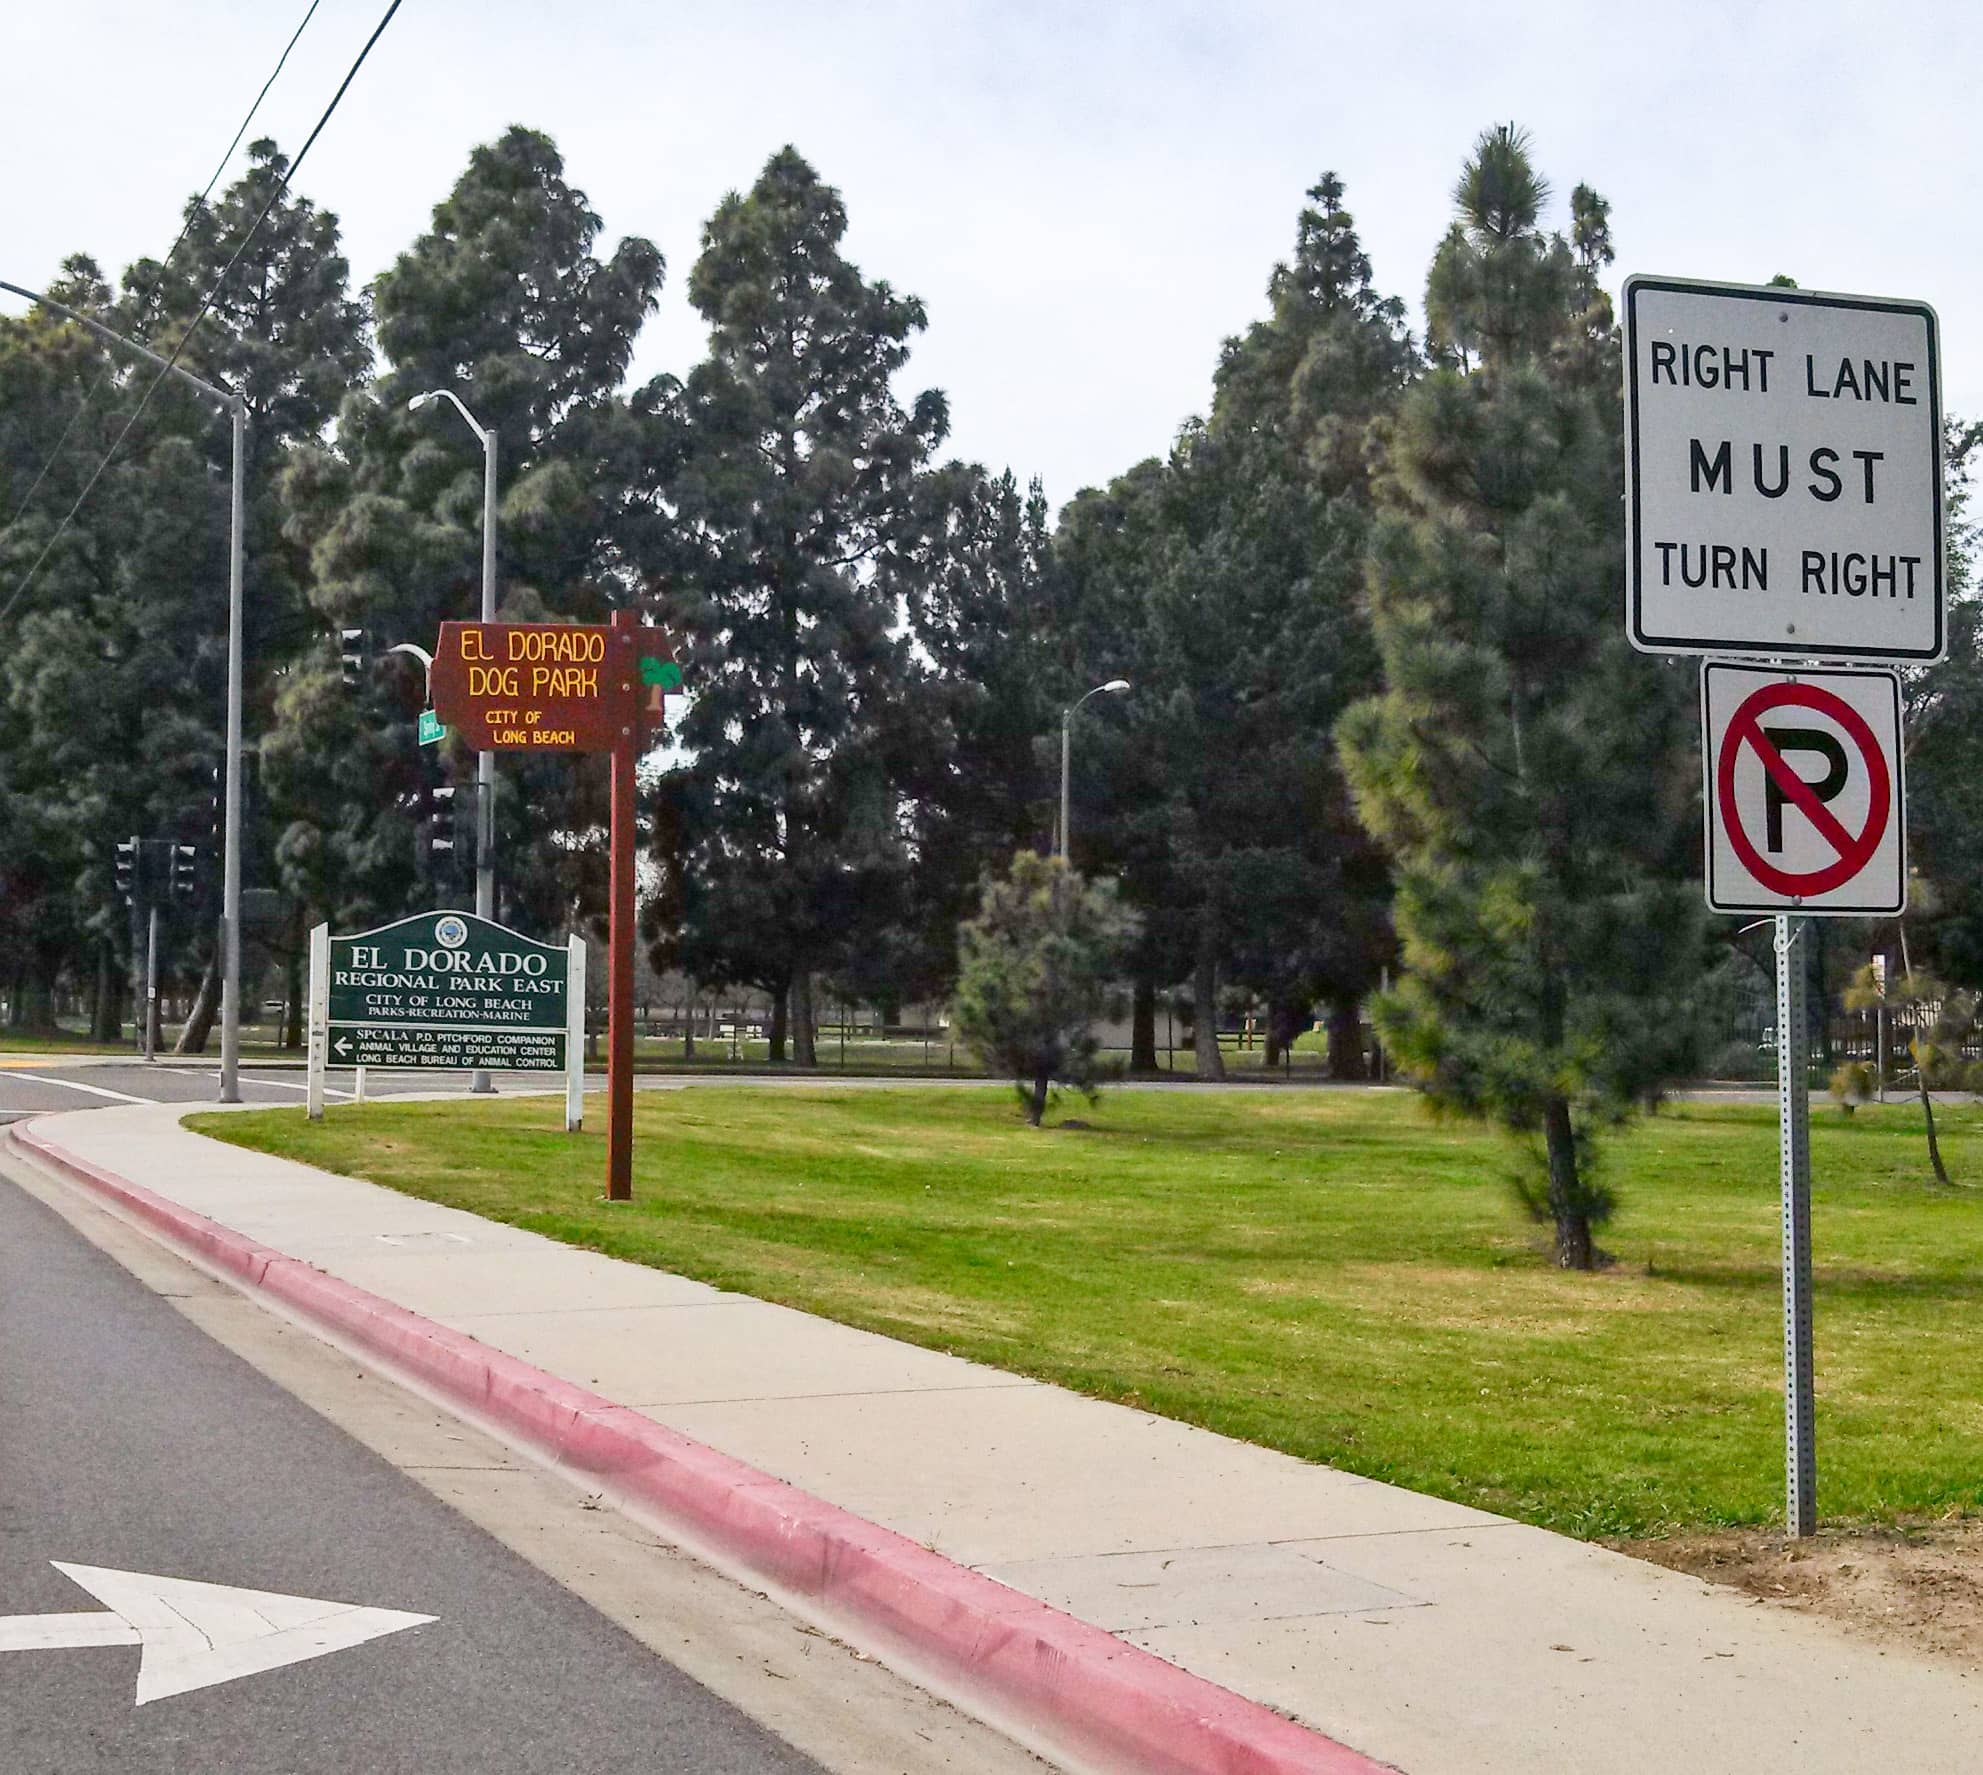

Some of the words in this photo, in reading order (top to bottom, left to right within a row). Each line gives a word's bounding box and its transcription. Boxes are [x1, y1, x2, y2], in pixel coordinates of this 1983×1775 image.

[1651, 341, 1774, 392] RIGHT
[1806, 354, 1917, 405] LANE
[1689, 439, 1884, 504] MUST
[1654, 542, 1767, 591] TURN
[1801, 551, 1921, 599] RIGHT
[460, 630, 494, 661] EL
[508, 631, 605, 663] DORADO
[469, 667, 519, 697] DOG
[532, 667, 598, 698] PARK
[485, 711, 518, 724] CITY
[525, 711, 542, 724] OF
[493, 730, 527, 744] LONG
[533, 731, 575, 745] BEACH
[1763, 727, 1849, 853] P
[351, 946, 388, 969] EL
[404, 948, 548, 976] DORADO
[335, 971, 440, 989] REGIONAL
[449, 976, 503, 992] PARK
[513, 978, 564, 994] EAST
[365, 993, 402, 1005] CITY
[409, 995, 429, 1007] OF
[436, 996, 477, 1009] LONG
[484, 998, 532, 1010] BEACH
[359, 1042, 394, 1052] ANIMAL
[398, 1043, 438, 1053] VILLAGE
[441, 1044, 461, 1054] AND
[465, 1045, 517, 1055] EDUCATION
[520, 1046, 557, 1057] CENTER
[437, 1033, 493, 1044] PITCHFORD
[497, 1035, 556, 1046] COMPANION
[356, 1053, 382, 1063] LONG
[386, 1054, 418, 1064] BEACH
[420, 1055, 458, 1065] BUREAU
[461, 1056, 475, 1066] OF
[479, 1057, 512, 1067] ANIMAL
[515, 1058, 558, 1068] CONTROL
